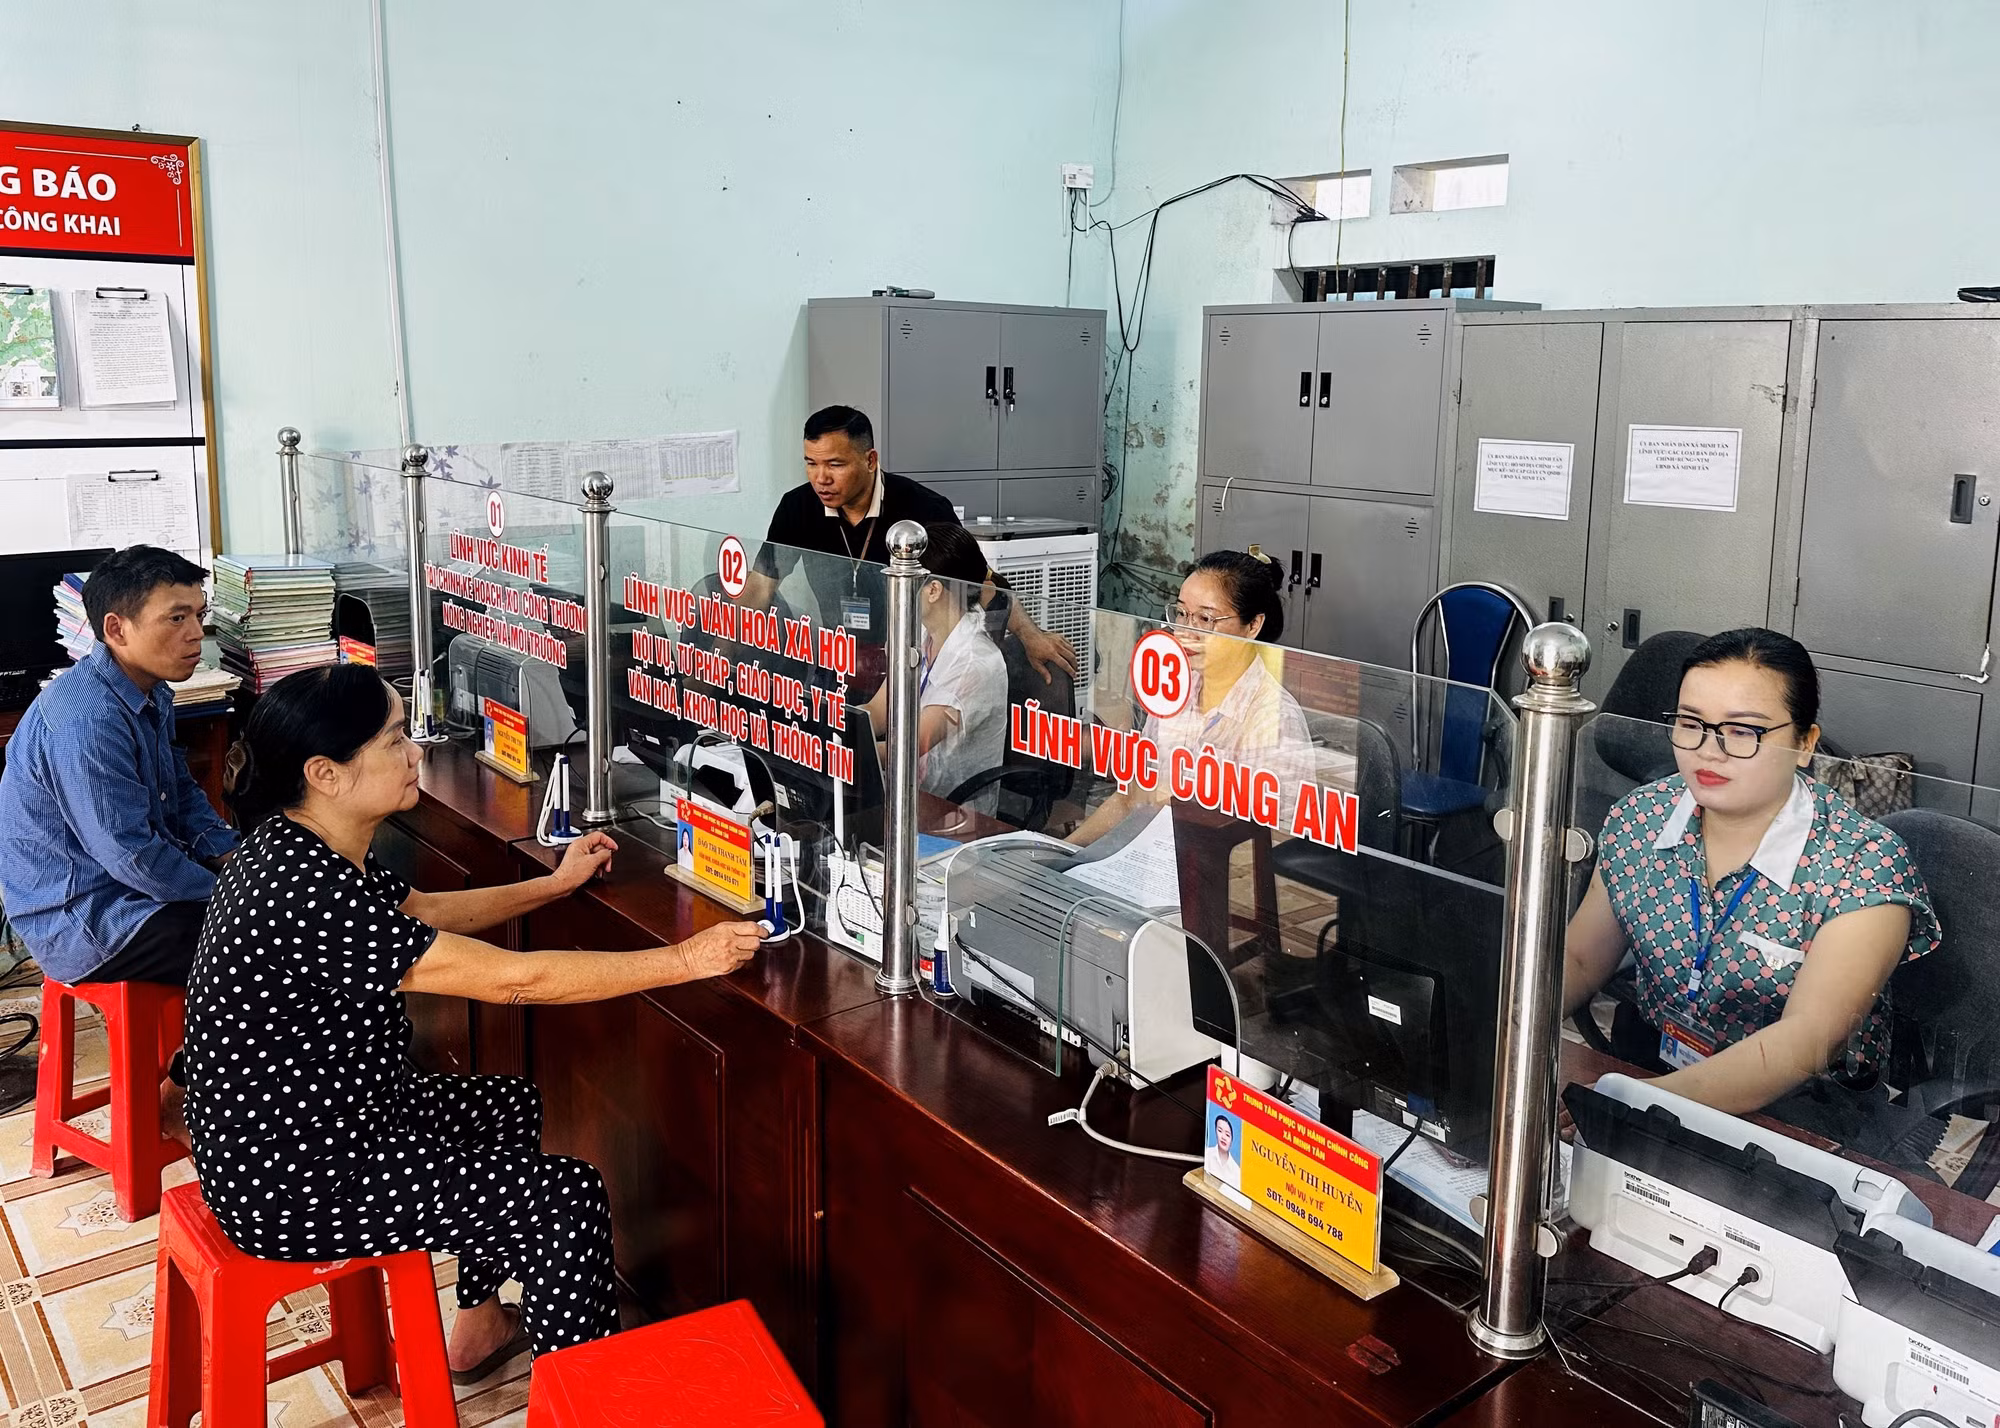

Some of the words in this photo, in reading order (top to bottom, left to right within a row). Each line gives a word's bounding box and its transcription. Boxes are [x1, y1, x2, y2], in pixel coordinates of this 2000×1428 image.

[33, 165, 116, 201] BÁO
[64, 213, 120, 236] KHAI
[490, 500, 502, 529] 01
[450, 528, 474, 564] LĨNH
[476, 539, 499, 574] VỰC
[501, 543, 530, 580] KINH
[532, 544, 549, 585] TẾ
[723, 549, 743, 585] 02
[424, 560, 437, 590] TÀI
[523, 588, 548, 624] CÔNG
[442, 599, 465, 632] NÔNG
[466, 606, 496, 646] NGHIỆP
[496, 616, 510, 648] VÀ
[510, 622, 529, 656] MÔI
[529, 629, 567, 670] TRƯỜNG
[623, 572, 660, 618] LĨNH
[663, 587, 696, 632] VỰC
[699, 592, 736, 642] VĂN
[740, 607, 781, 655] HOÁ
[784, 614, 814, 665] XÃ
[819, 624, 857, 684] HỘI
[632, 626, 653, 670] NỘI
[654, 636, 675, 676] VỤ,
[676, 641, 694, 677] TƯ
[694, 648, 733, 696] PHÁP,
[736, 660, 770, 705] GIÁO
[773, 673, 809, 722] DỤC,
[810, 685, 822, 723] Y
[826, 684, 848, 732] TẾ
[1140, 648, 1181, 702] 03
[628, 667, 653, 701] VĂN
[653, 678, 682, 720] HOÁ,
[683, 688, 718, 730] KHOA
[720, 704, 748, 745] HỌC
[750, 709, 770, 752] VÀ
[772, 722, 822, 773] THÔNG
[826, 740, 854, 785] TIN
[1010, 697, 1083, 770] LĨNH
[1089, 723, 1160, 796] VỰC
[1169, 743, 1281, 831] CÔNG
[1290, 780, 1360, 856] AN
[1242, 1092, 1263, 1110] TRUNG
[1264, 1104, 1278, 1120] TÂM
[1278, 1112, 1296, 1130] PHỤC
[1297, 1123, 1306, 1136] VỤ
[1307, 1127, 1326, 1146] HÀNH
[1327, 1137, 1348, 1158] CHÍNH
[1349, 1149, 1369, 1170] CÔNG
[1293, 1136, 1311, 1153] MINH
[1312, 1147, 1326, 1161] TÂN
[1251, 1140, 1297, 1176] NGUYỄN
[1299, 1168, 1320, 1192] THỊ
[1266, 1187, 1284, 1206] SĐT:
[1285, 1200, 1306, 1220] 0948
[1308, 1213, 1324, 1231] 694
[1326, 1223, 1344, 1241] 788
